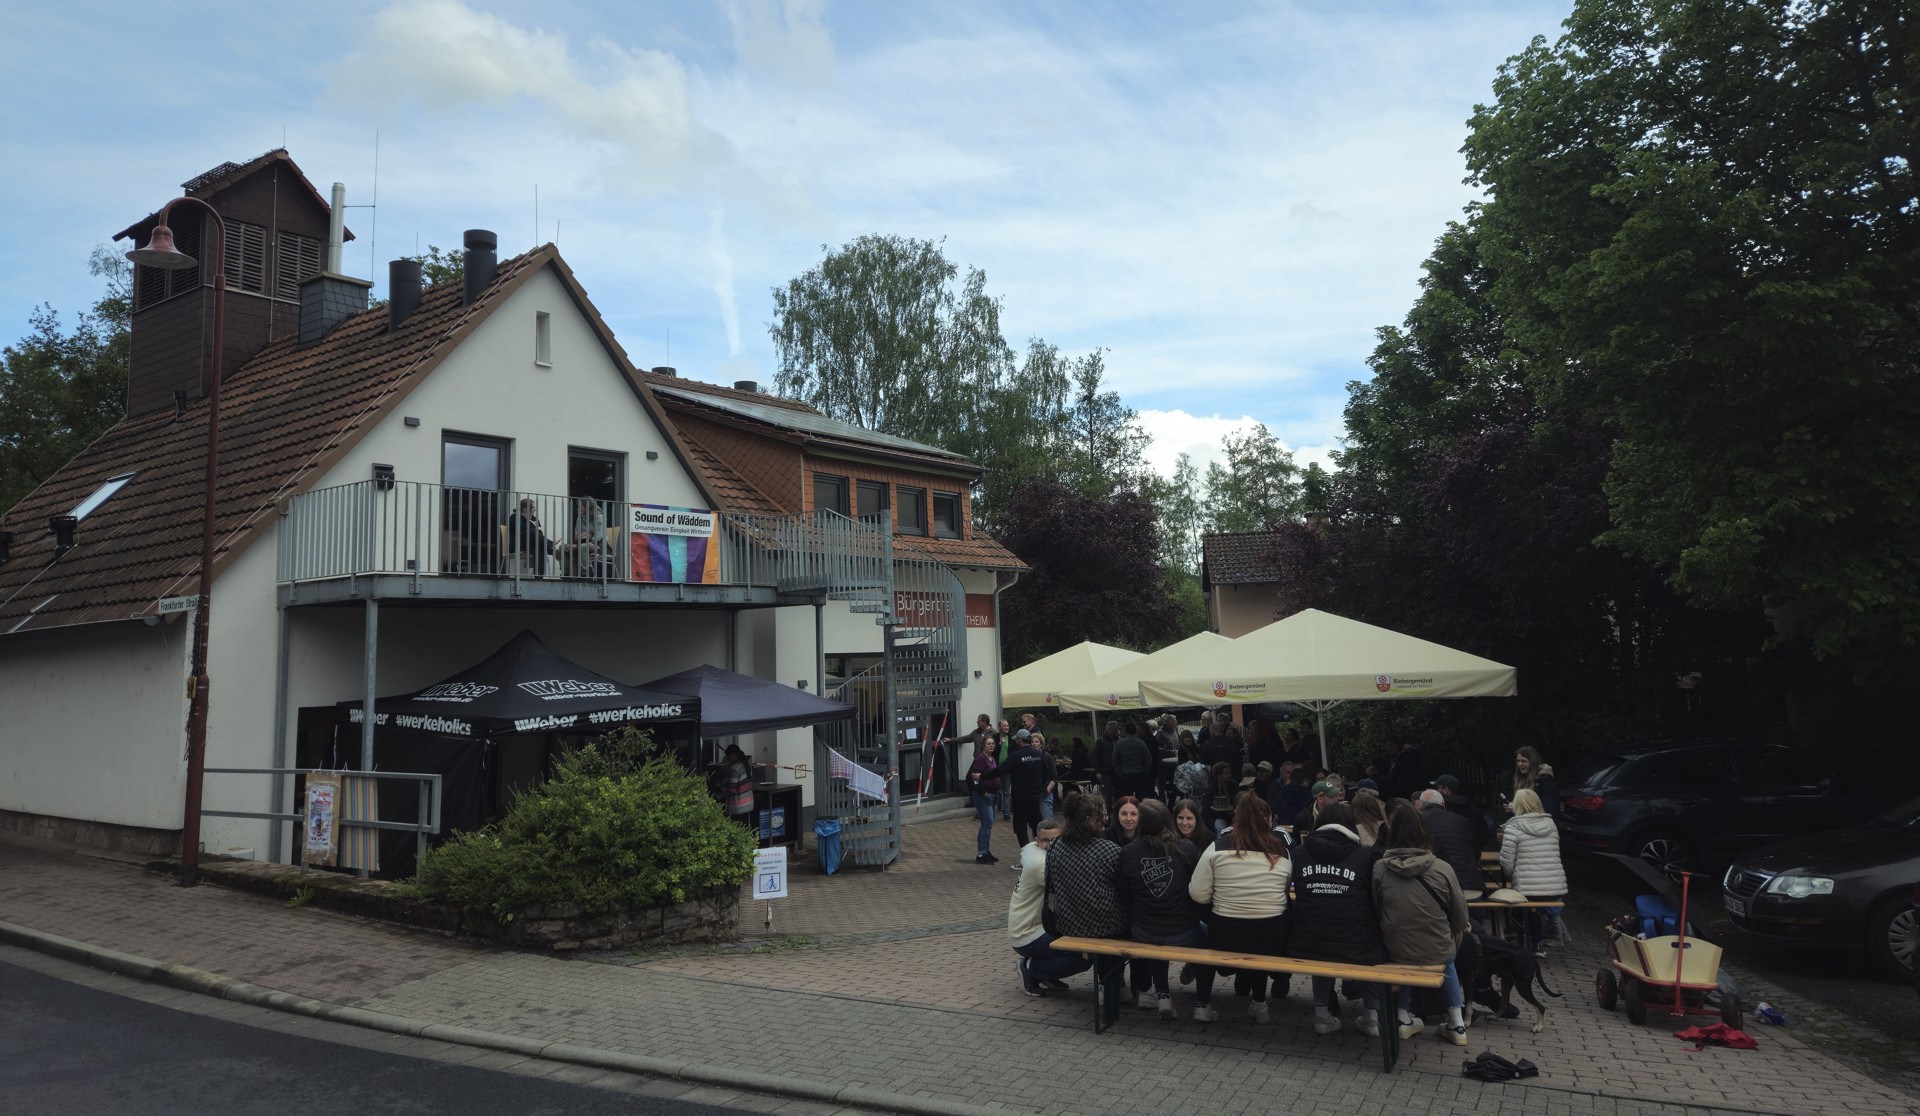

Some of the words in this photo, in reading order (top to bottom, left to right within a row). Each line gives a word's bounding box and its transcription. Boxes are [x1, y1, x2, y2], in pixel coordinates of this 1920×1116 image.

[634, 511, 664, 524] Sound
[666, 514, 676, 525] of
[678, 514, 711, 528] Wäddem
[634, 524, 669, 532] Gesangverein
[966, 615, 989, 626] THEIM
[395, 714, 472, 736] #werkeholics
[514, 714, 578, 732] Weber
[588, 703, 682, 724] #werkeholics
[1146, 864, 1168, 881] HAITZ
[1302, 865, 1313, 877] SG
[1315, 864, 1341, 876] Haitz
[1343, 868, 1356, 881] 08
